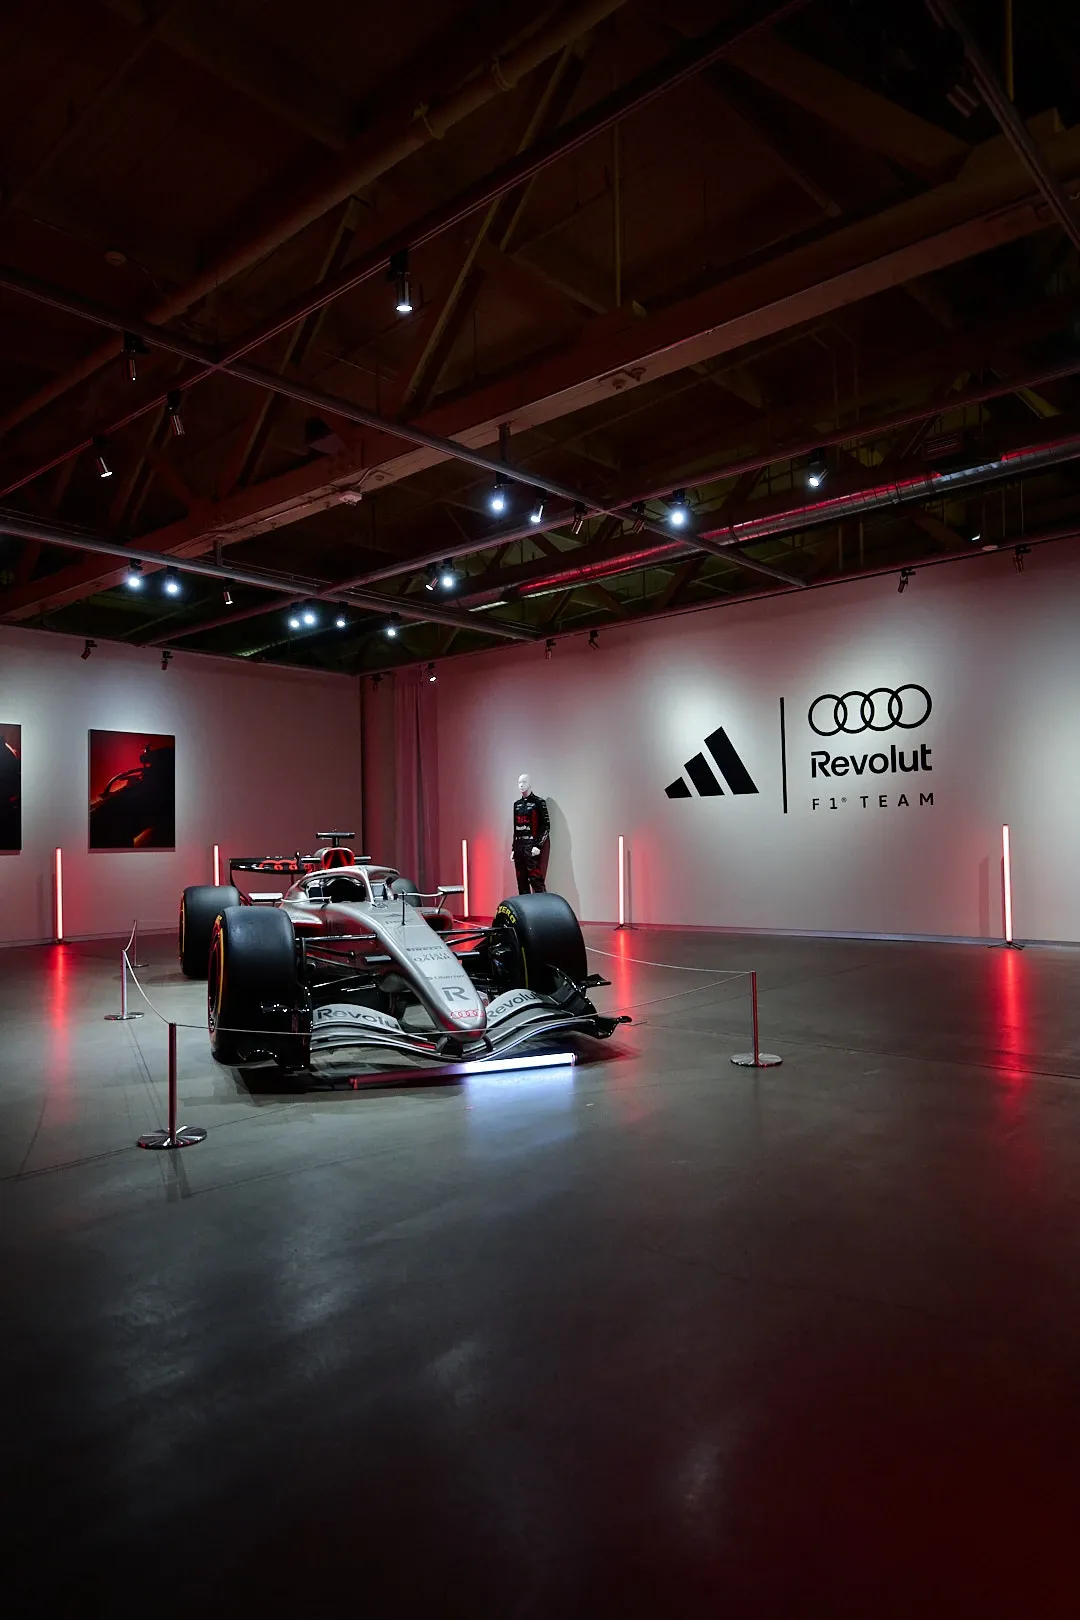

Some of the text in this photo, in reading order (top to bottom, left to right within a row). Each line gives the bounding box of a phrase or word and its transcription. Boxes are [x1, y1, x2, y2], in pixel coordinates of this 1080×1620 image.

[811, 744, 932, 778] Revolut
[860, 793, 934, 808] TEAM
[317, 1008, 400, 1029] Revolu
[487, 992, 538, 1022] Revolu
